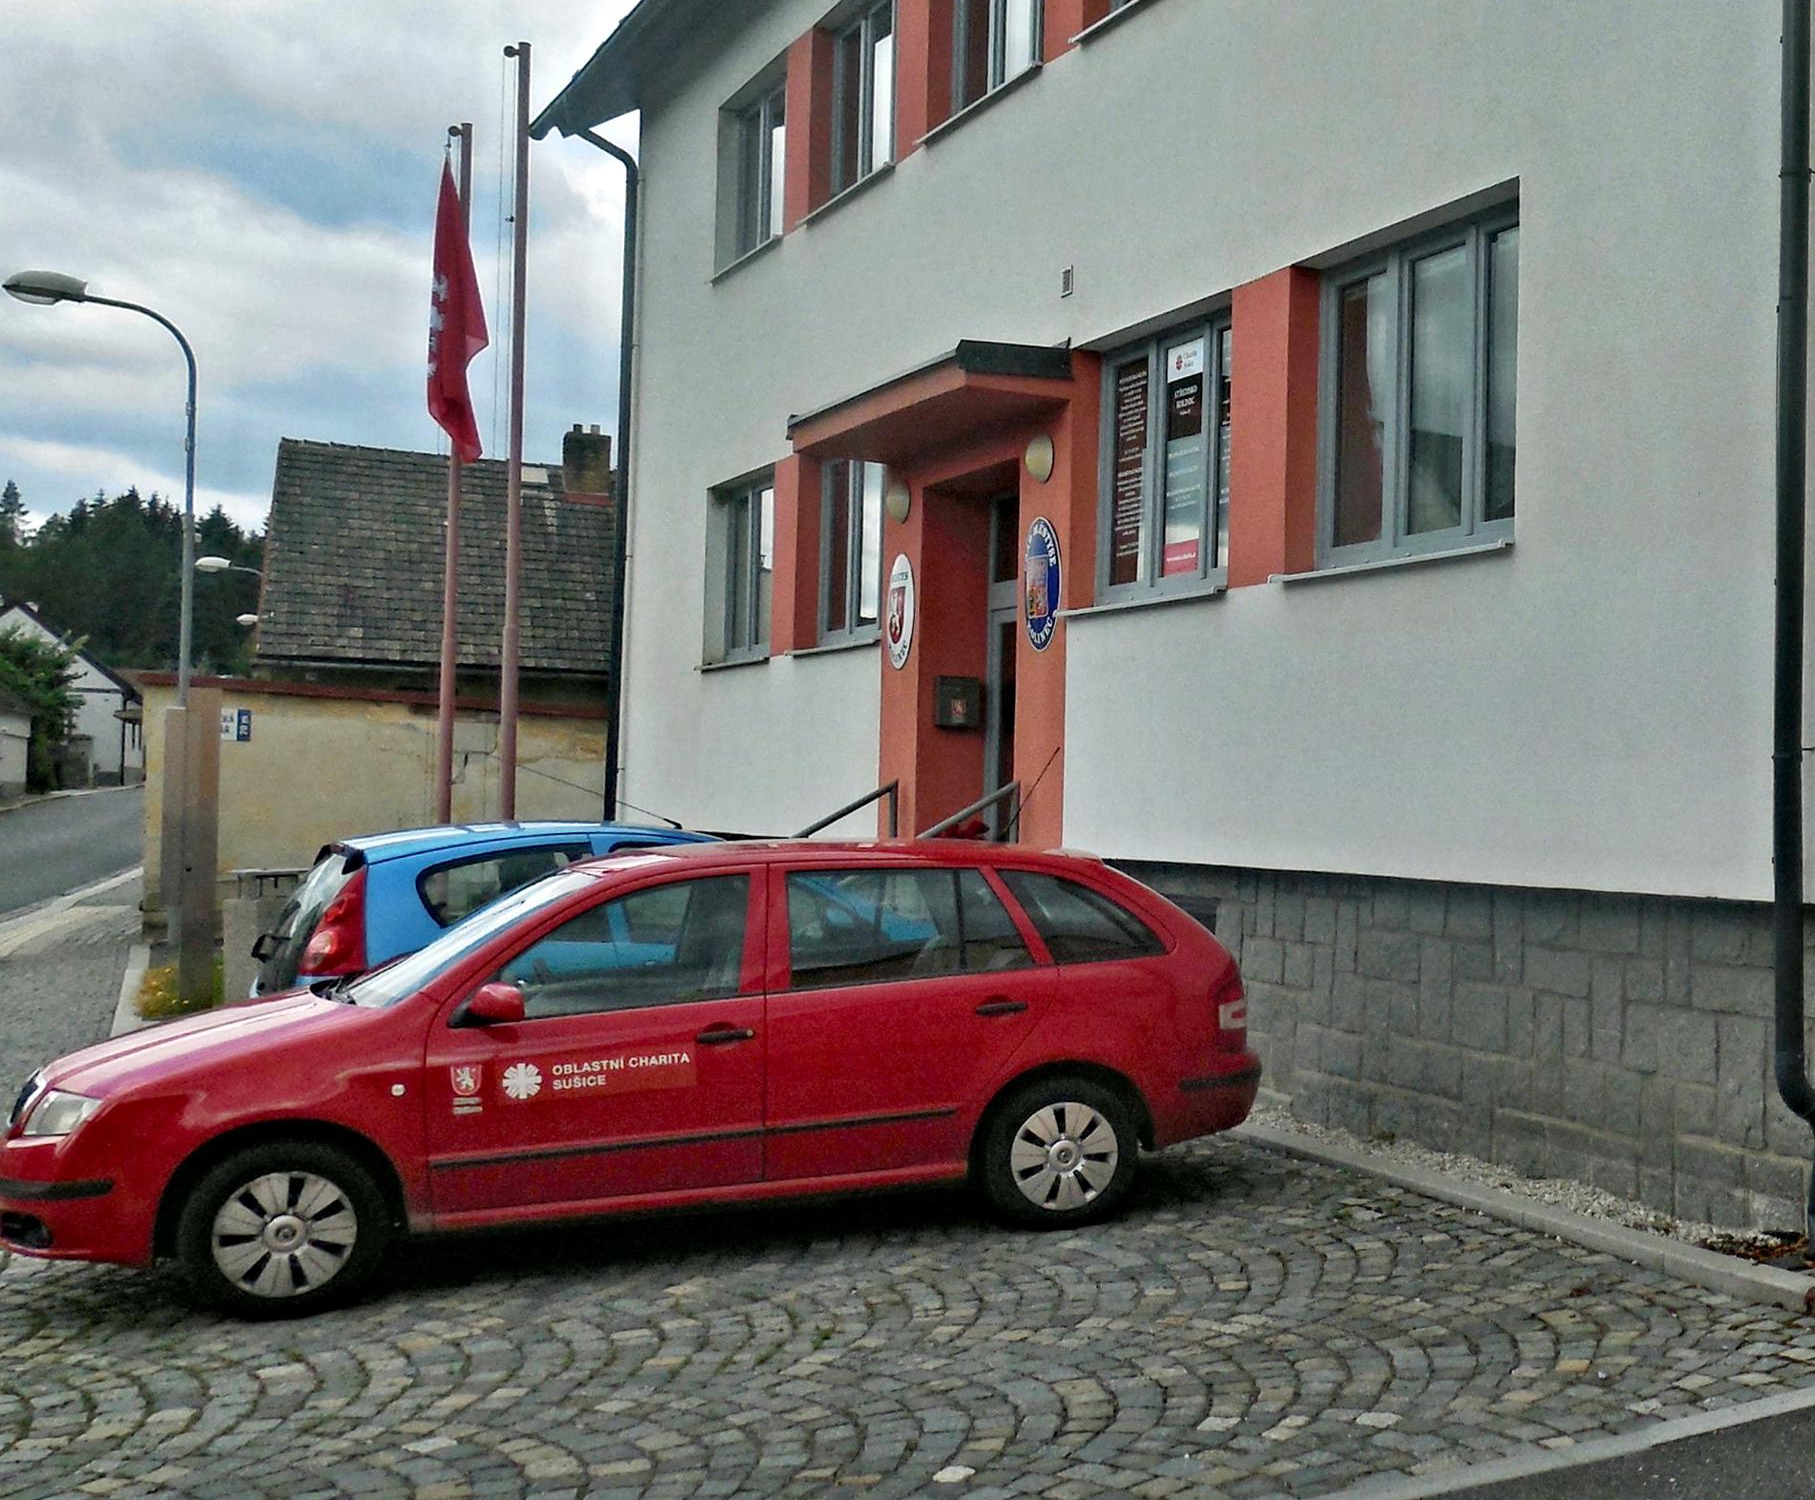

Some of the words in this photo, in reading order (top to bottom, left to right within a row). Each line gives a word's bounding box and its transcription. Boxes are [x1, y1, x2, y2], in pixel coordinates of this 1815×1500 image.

[552, 1058, 625, 1076] OBLASTNÍ
[628, 1052, 691, 1068] CHARITA
[552, 1075, 607, 1091] SUŠICE
